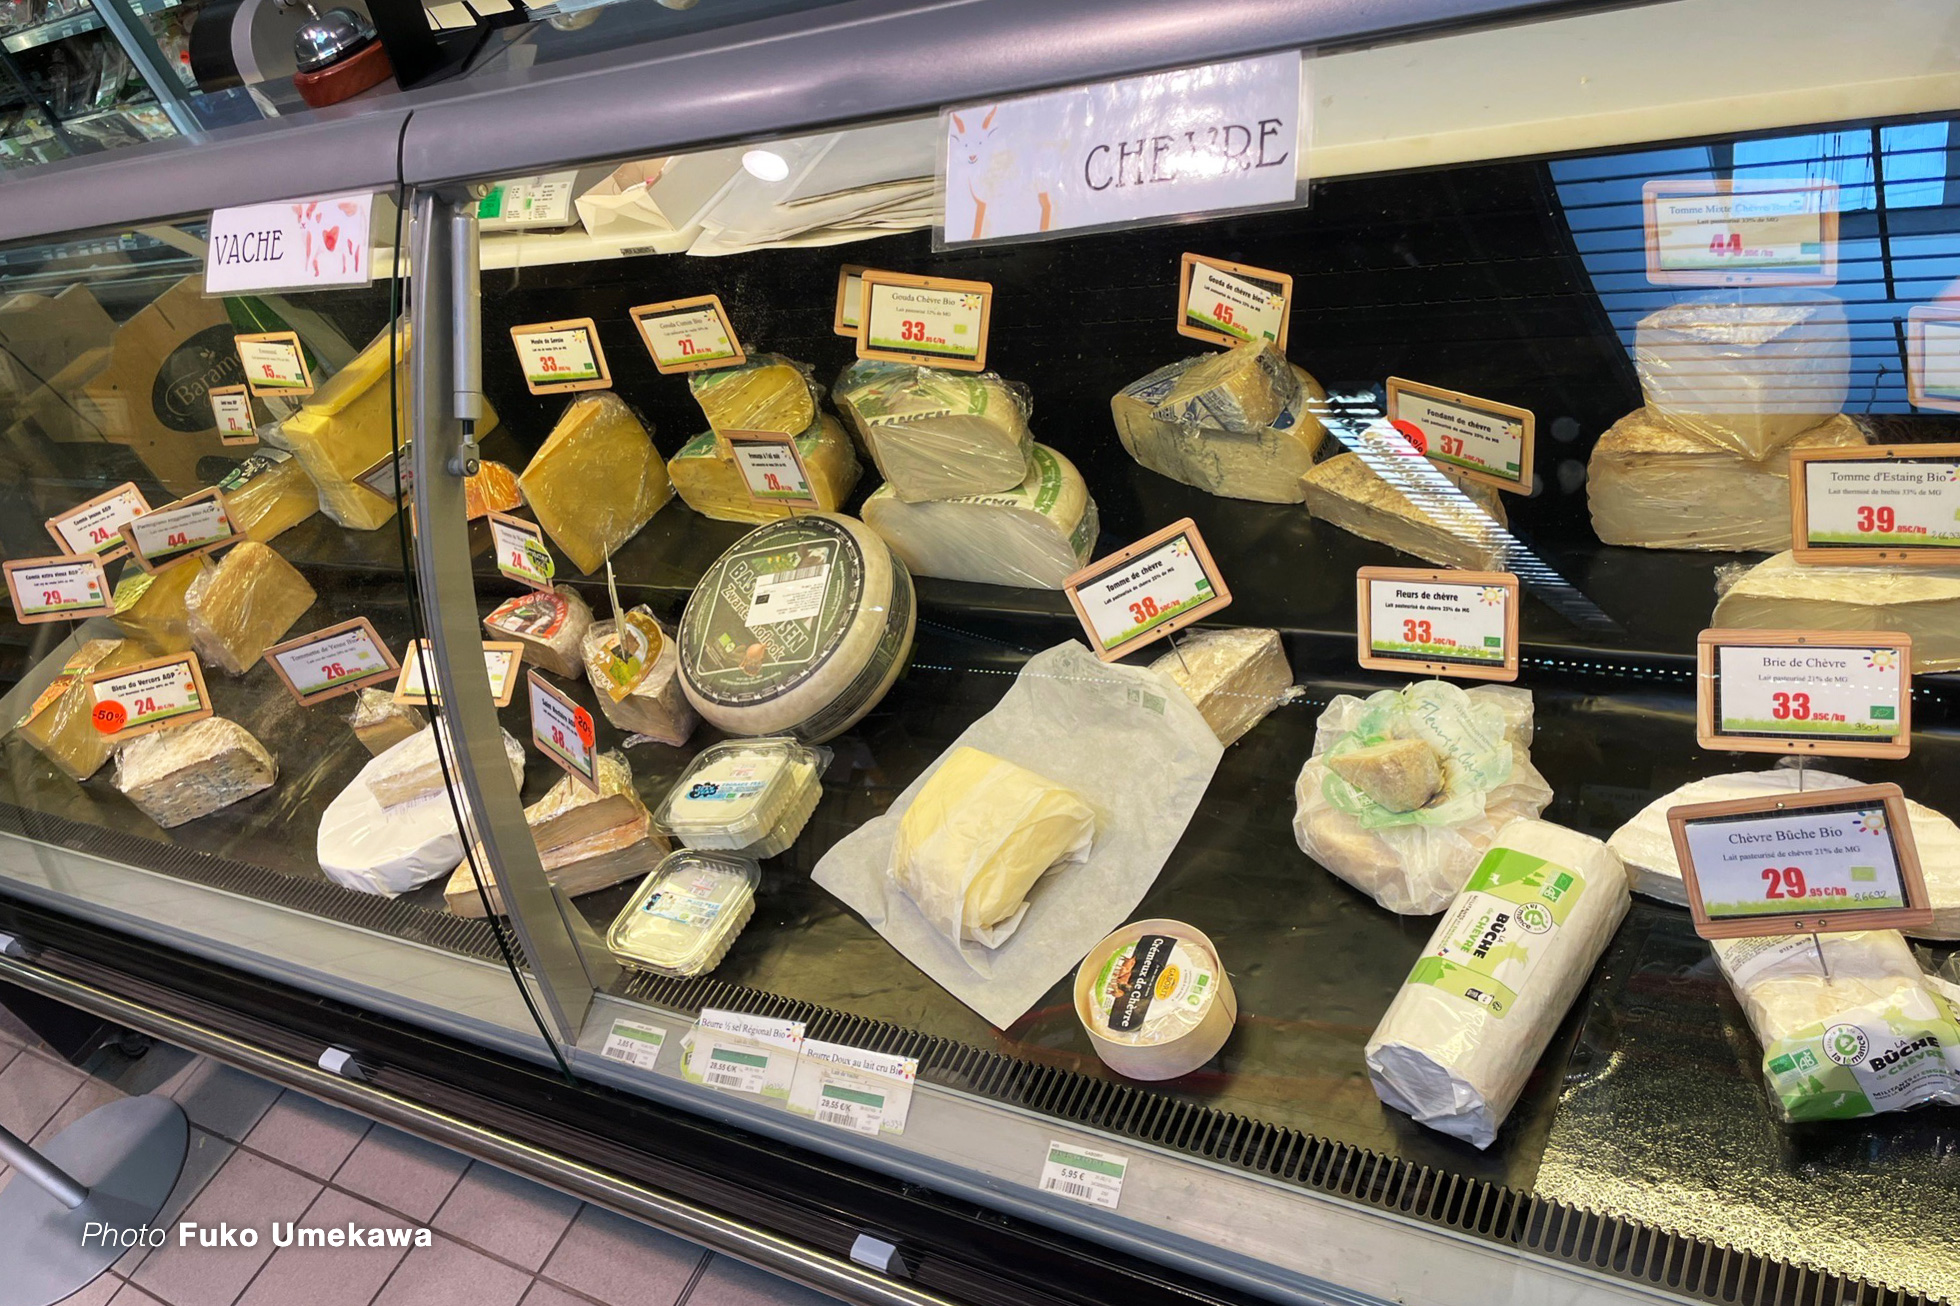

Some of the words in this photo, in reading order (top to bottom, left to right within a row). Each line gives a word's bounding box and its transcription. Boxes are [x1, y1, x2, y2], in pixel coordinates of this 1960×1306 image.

[1669, 206, 1703, 214] Tomme
[1706, 206, 1731, 214] Mixte
[215, 230, 283, 266] VACHE
[1709, 234, 1743, 257] 44
[1209, 275, 1225, 287] Gouda
[1234, 287, 1251, 298] chèvre
[892, 293, 915, 302] Gouda
[916, 295, 941, 305] Chèvre
[1213, 303, 1233, 325] 45
[901, 320, 925, 341] 33
[678, 339, 695, 355] 27
[262, 364, 275, 379] 15
[540, 356, 557, 372] 33
[1427, 409, 1455, 421] Fondant
[1456, 417, 1466, 426] de
[1468, 420, 1491, 432] chèvre
[1440, 434, 1464, 457] 37
[764, 473, 780, 490] 28
[1831, 472, 1870, 481] Tomme
[1873, 472, 1923, 484] d'Estaing
[1927, 472, 1946, 482] Bio
[1857, 506, 1895, 533] 39
[89, 527, 109, 544] 24
[168, 532, 187, 547] 44
[512, 551, 522, 569] 24
[1106, 578, 1130, 593] Tomme
[1131, 572, 1140, 580] de
[1141, 560, 1163, 576] chèvre
[43, 590, 62, 605] 29
[1396, 590, 1418, 599] Fleurs
[1421, 591, 1431, 599] de
[1433, 592, 1458, 601] chèvre
[1128, 596, 1159, 624] 38
[1403, 619, 1432, 644] 33
[321, 662, 346, 680] 26
[1763, 657, 1786, 667] Brie
[1790, 658, 1802, 667] de
[1806, 658, 1846, 668] Chèvre
[111, 684, 127, 692] Bleu
[137, 676, 161, 686] Vercors
[1824, 675, 1833, 683] de
[134, 697, 156, 715] 24
[1772, 692, 1810, 720] 33
[92, 710, 125, 724] -50%
[551, 725, 564, 749] 38
[1728, 830, 1773, 844] Chèvre
[1775, 827, 1816, 841] Bûche
[1820, 827, 1843, 838] Bio
[1740, 850, 1776, 861] pasteurisé
[1787, 849, 1813, 858] chèvre
[1814, 847, 1832, 855] 21%
[1834, 847, 1843, 855] de
[1845, 845, 1861, 853] MG
[1761, 866, 1808, 899] 29
[1460, 915, 1490, 953] CHÈVRE
[1473, 913, 1510, 959] BÛCHE
[1139, 938, 1164, 978] Crémeux
[1135, 977, 1146, 990] de
[1121, 989, 1141, 1028] Chèvre
[702, 1018, 722, 1029] Beurre
[732, 1023, 742, 1031] sel
[742, 1024, 771, 1037] Régional
[773, 1029, 785, 1038] Bio
[1894, 1039, 1908, 1049] LA
[807, 1048, 830, 1061] Beurre
[832, 1053, 851, 1066] Doux
[852, 1059, 861, 1067] au
[862, 1060, 874, 1070] lait
[876, 1064, 888, 1073] cru
[1800, 1052, 1815, 1070] AB
[1832, 1052, 1841, 1062] la
[1868, 1036, 1941, 1073] BÛCHE
[1873, 1077, 1913, 1097] MILITANTS
[1061, 1168, 1078, 1179] 5,95
[1079, 1172, 1085, 1181] €
